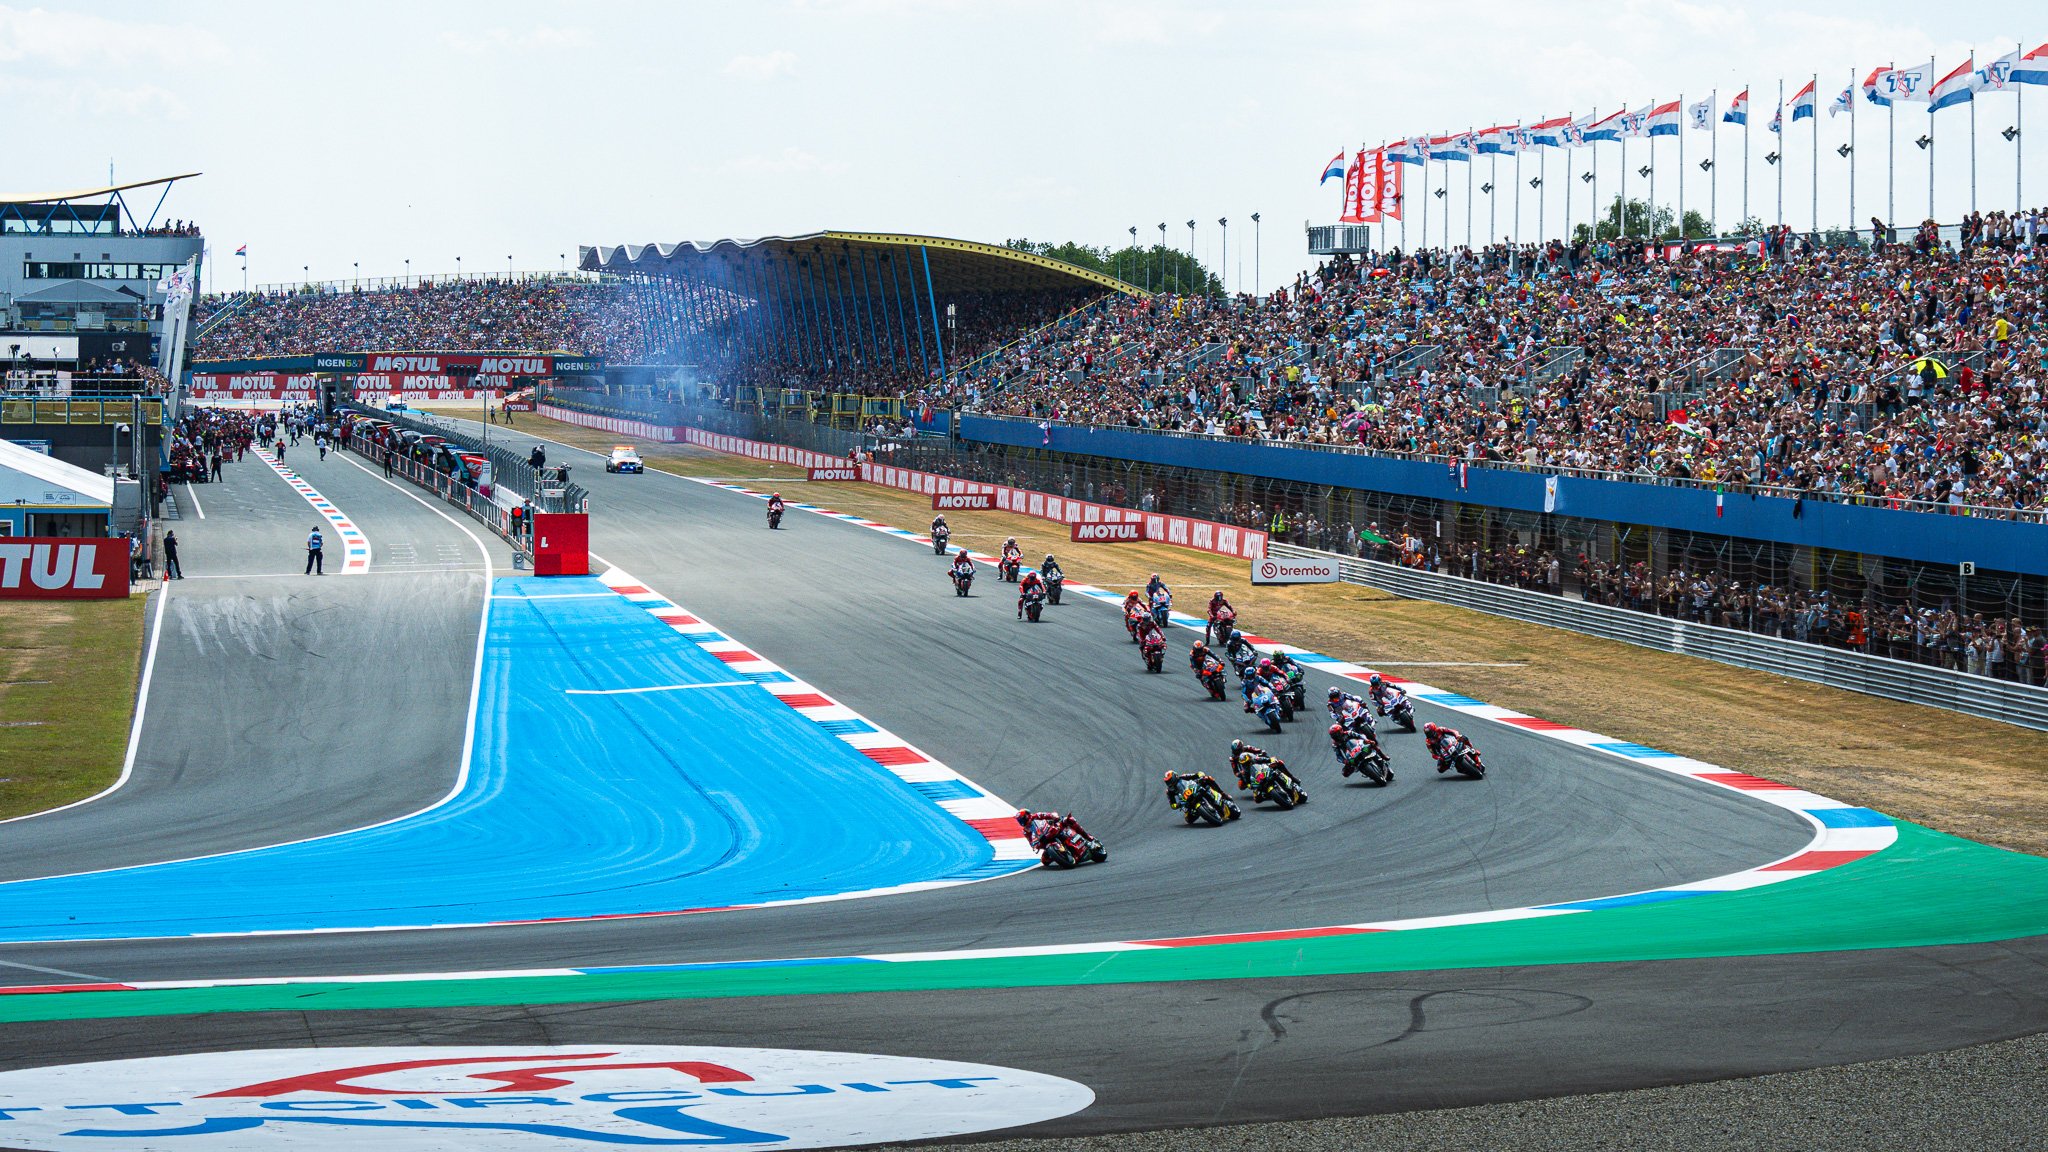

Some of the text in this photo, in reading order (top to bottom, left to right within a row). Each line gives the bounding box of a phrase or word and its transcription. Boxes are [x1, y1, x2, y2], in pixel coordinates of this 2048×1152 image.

[1976, 62, 2010, 84] TT
[1886, 73, 1922, 93] TT
[1361, 152, 1378, 218] MOTUL
[317, 358, 364, 369] NGEN5&7
[373, 356, 441, 373] MOTUL
[479, 358, 547, 374] MOTUL
[556, 361, 602, 372] NGEN5&7
[229, 376, 276, 390] MOTUL
[403, 375, 451, 389] MOTUL
[204, 390, 311, 400] MOTUL MOTUL MOTUL
[438, 391, 465, 400] MOTUL
[813, 469, 856, 480] MOTUL
[938, 495, 989, 508] MOTUL
[1078, 524, 1139, 538] MOTUL
[1168, 518, 1188, 545] MOTUL
[1192, 522, 1213, 550] MOTUL
[1217, 526, 1238, 555] MOTUL
[1243, 531, 1264, 560] MOTUL
[1280, 565, 1330, 576] brembo
[1963, 563, 1972, 574] B
[259, 1076, 998, 1111] CIRCUIT
